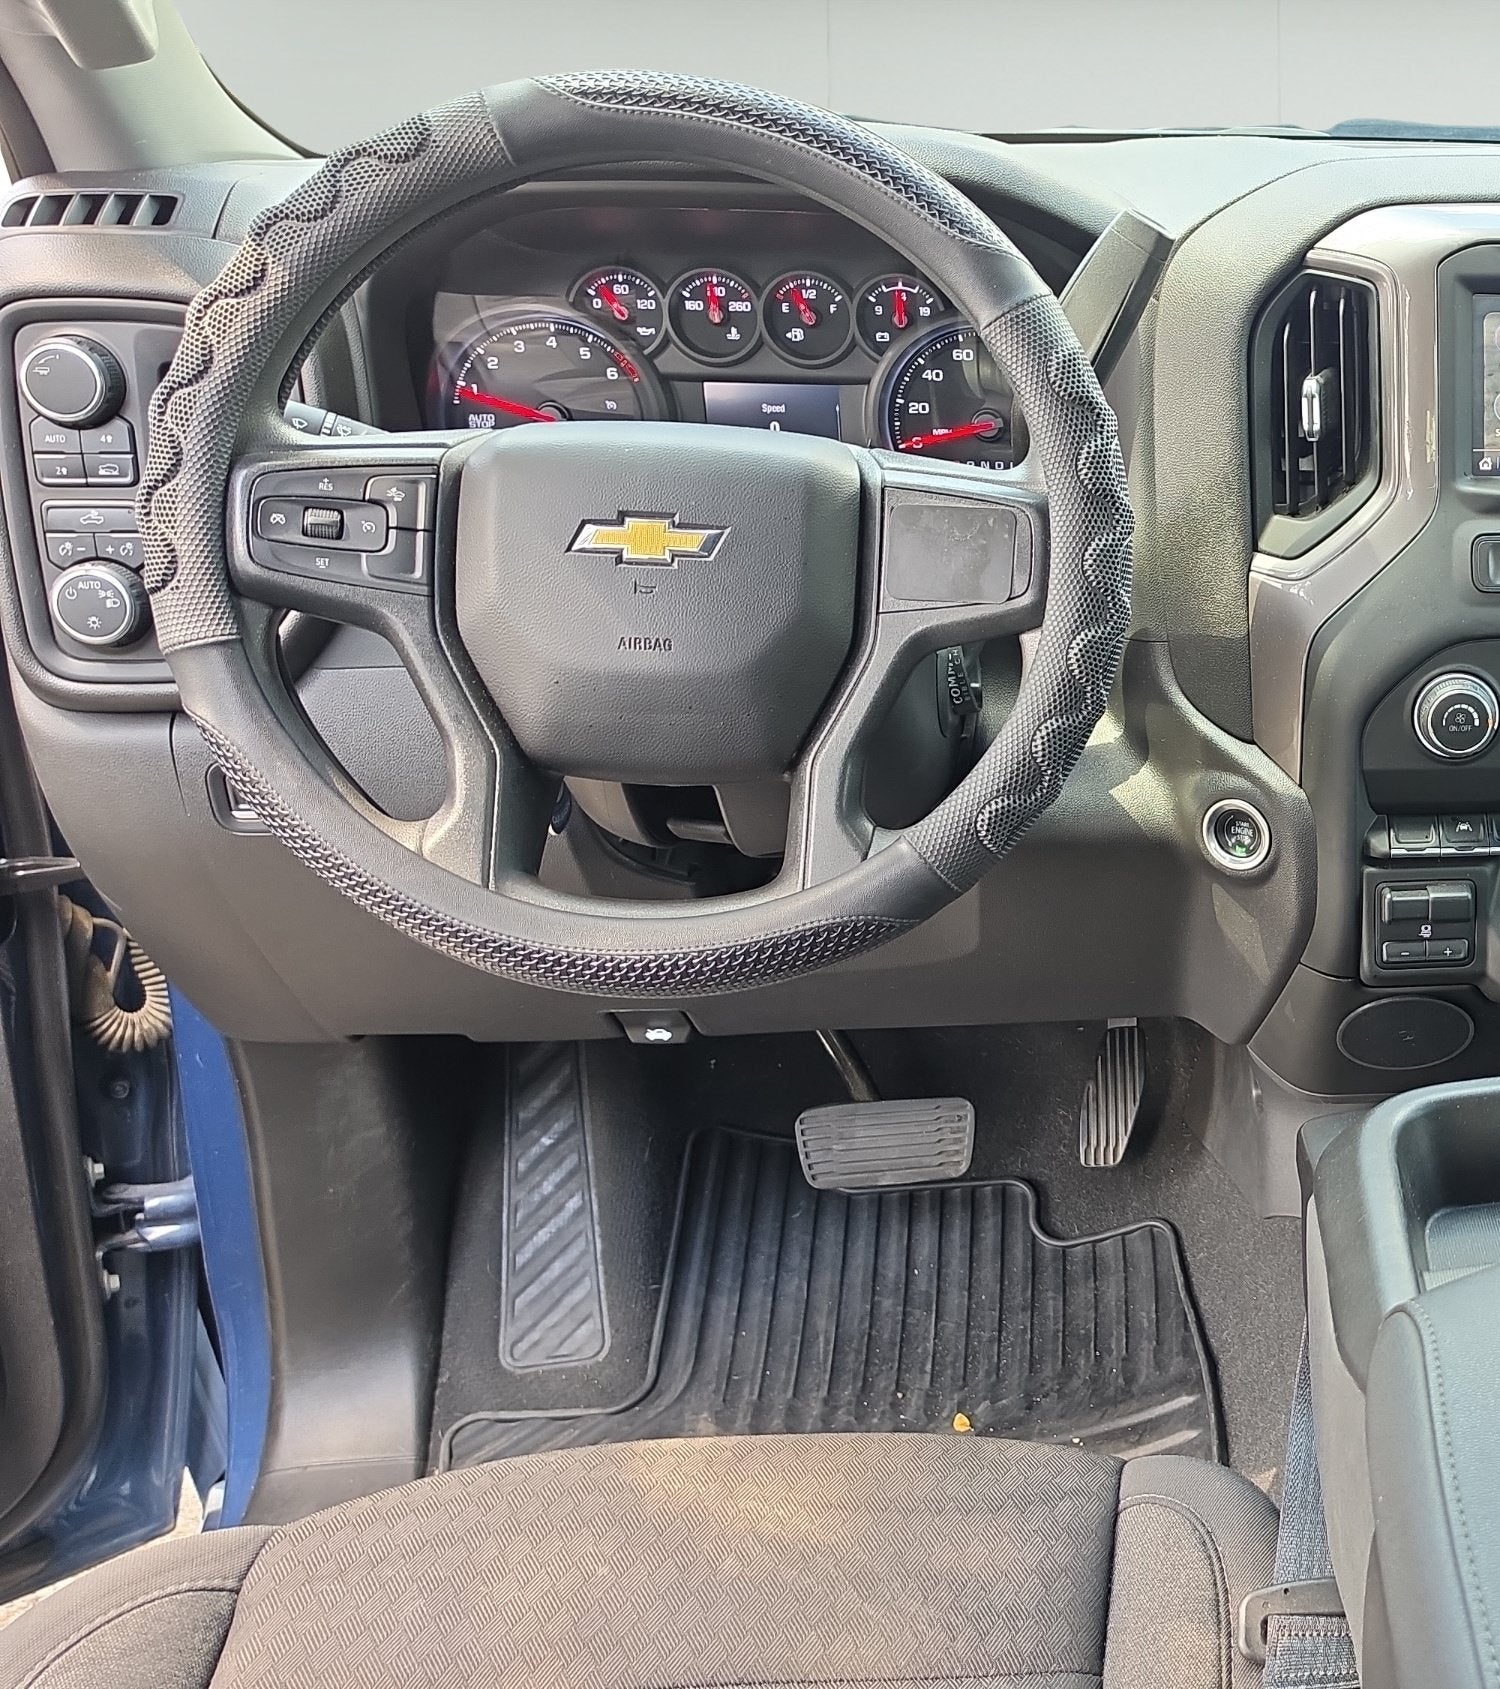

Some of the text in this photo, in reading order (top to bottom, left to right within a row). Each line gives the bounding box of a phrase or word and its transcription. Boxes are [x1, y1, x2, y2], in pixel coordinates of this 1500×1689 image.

[613, 284, 629, 294] 60
[801, 289, 816, 299] 1/2
[592, 298, 602, 308] 0
[636, 299, 656, 310] 120
[684, 300, 704, 311] 160
[728, 301, 752, 312] 260
[782, 302, 790, 312] E
[829, 304, 837, 314] F
[874, 305, 883, 315] 9
[918, 306, 931, 317] 19
[514, 340, 526, 353] 3
[545, 336, 558, 348] 4
[579, 347, 591, 359] 5
[952, 349, 974, 362] 60
[486, 356, 499, 370] 2
[606, 367, 619, 380] 6
[921, 369, 944, 382] 40
[761, 403, 786, 414] Speed
[908, 402, 930, 414] 20
[468, 413, 496, 422] AUTO
[45, 434, 66, 443] AUTO
[318, 482, 333, 491] RES
[315, 557, 330, 566] SET
[78, 581, 101, 590] AUTO
[617, 636, 673, 651] AIRBAG
[1231, 827, 1253, 837] ENGINE
